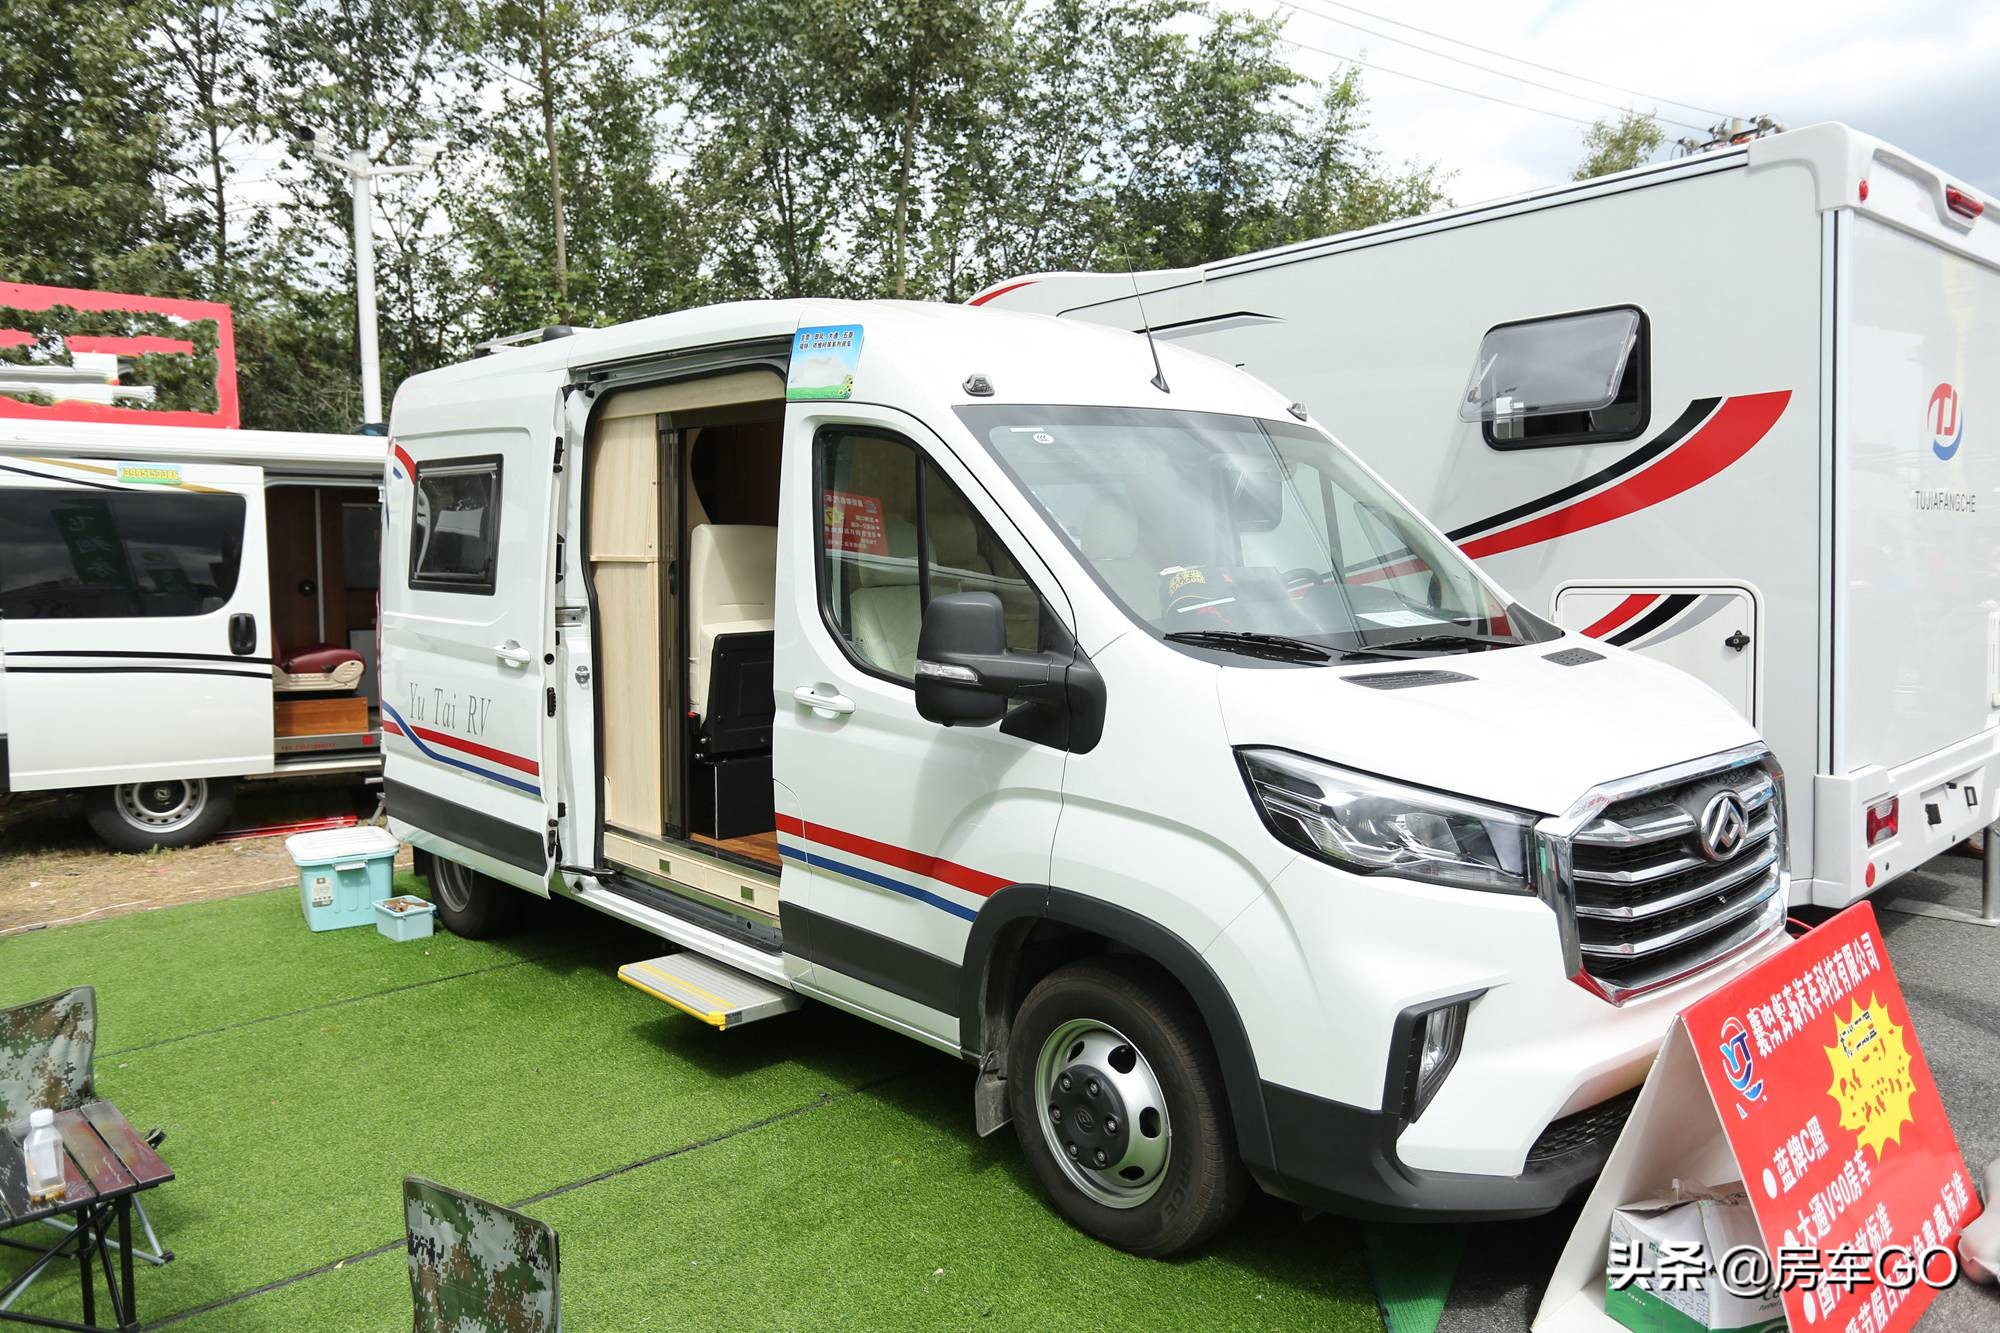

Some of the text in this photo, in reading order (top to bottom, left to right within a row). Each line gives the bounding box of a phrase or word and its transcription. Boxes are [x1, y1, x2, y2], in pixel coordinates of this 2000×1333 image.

[1915, 490, 1976, 513] TUJIAFANGCHE
[409, 681, 492, 736] Yu Tai RV
[1773, 1115, 1829, 1193] 蓝牌C照
[1796, 1149, 1871, 1247] 大通V90房车
